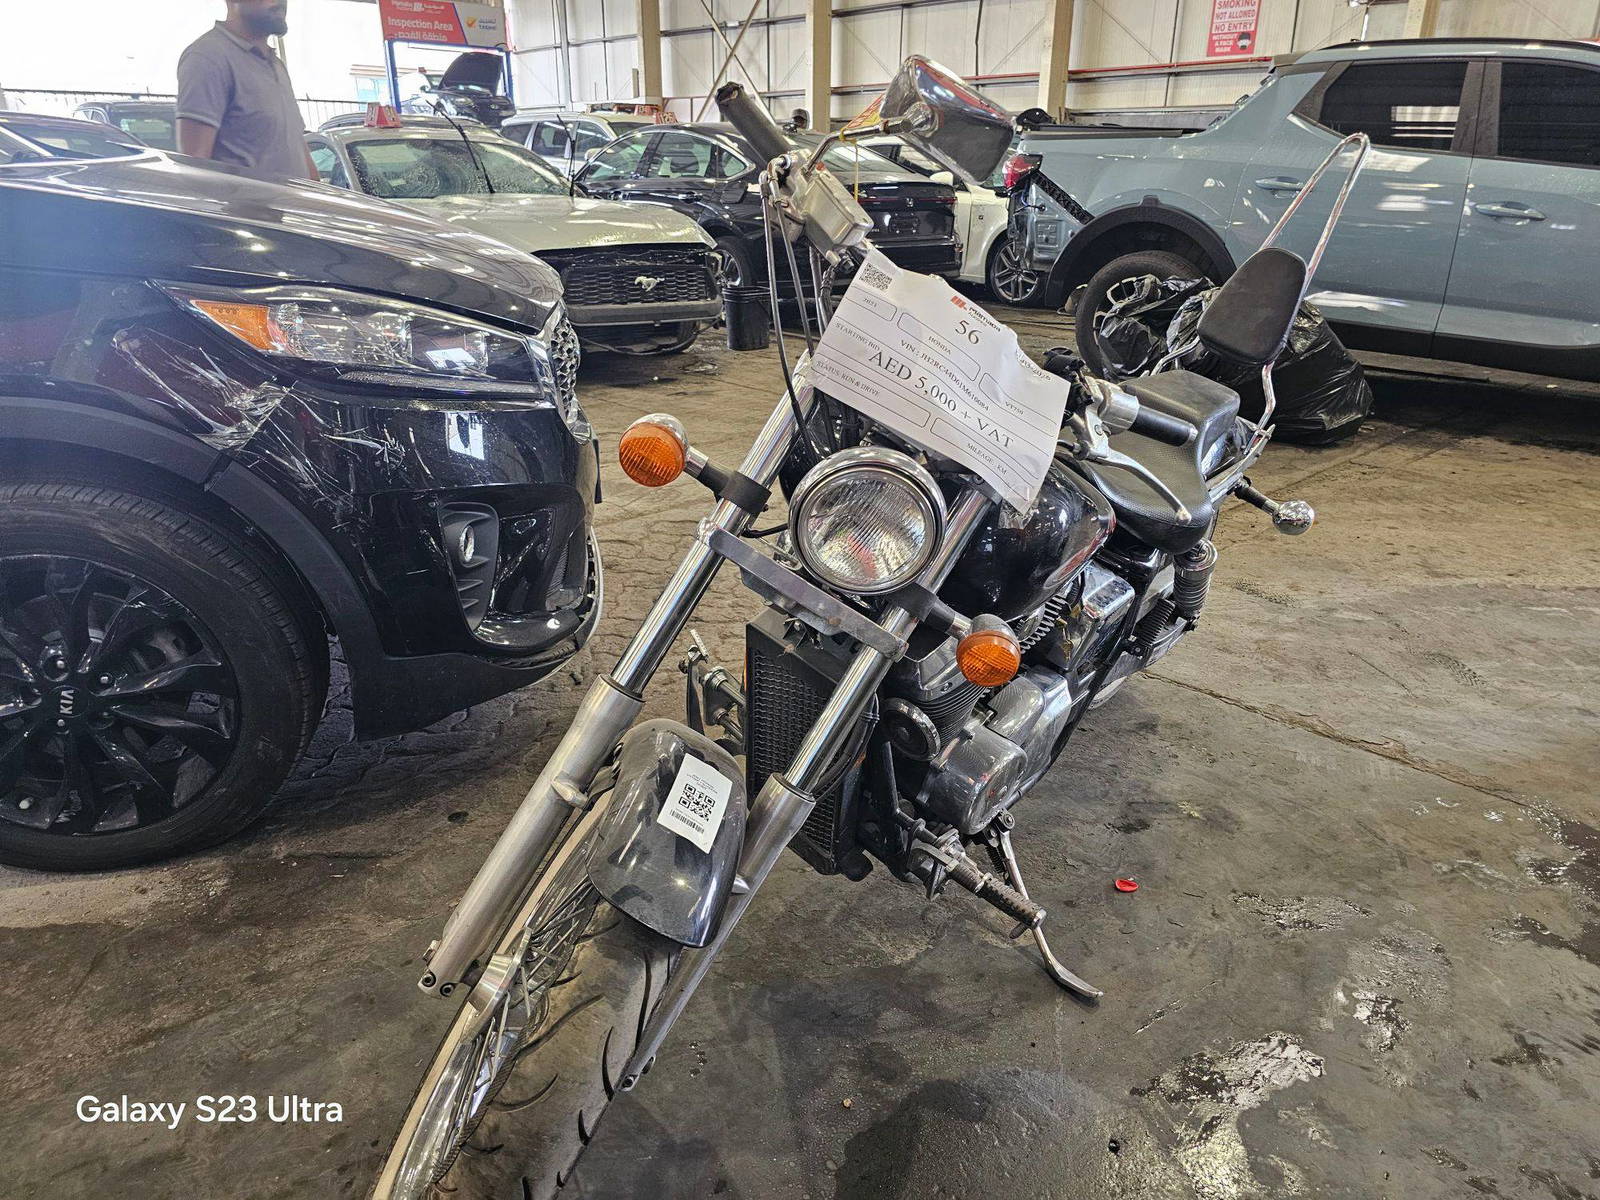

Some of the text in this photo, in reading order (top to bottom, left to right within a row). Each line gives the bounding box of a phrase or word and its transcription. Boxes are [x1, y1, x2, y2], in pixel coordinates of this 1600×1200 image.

[1217, 0, 1257, 9] SMOKING
[1216, 9, 1256, 20] NOT ALLOWED
[387, 16, 454, 31] Inspection Area
[1215, 20, 1254, 32] NO ENTRY
[955, 320, 983, 345] 56
[901, 339, 916, 354] VIN
[928, 335, 952, 356] HONDA
[868, 350, 912, 381] AED
[914, 376, 957, 412] 5,000
[977, 417, 1014, 448] VAT
[60, 689, 75, 715] KIA
